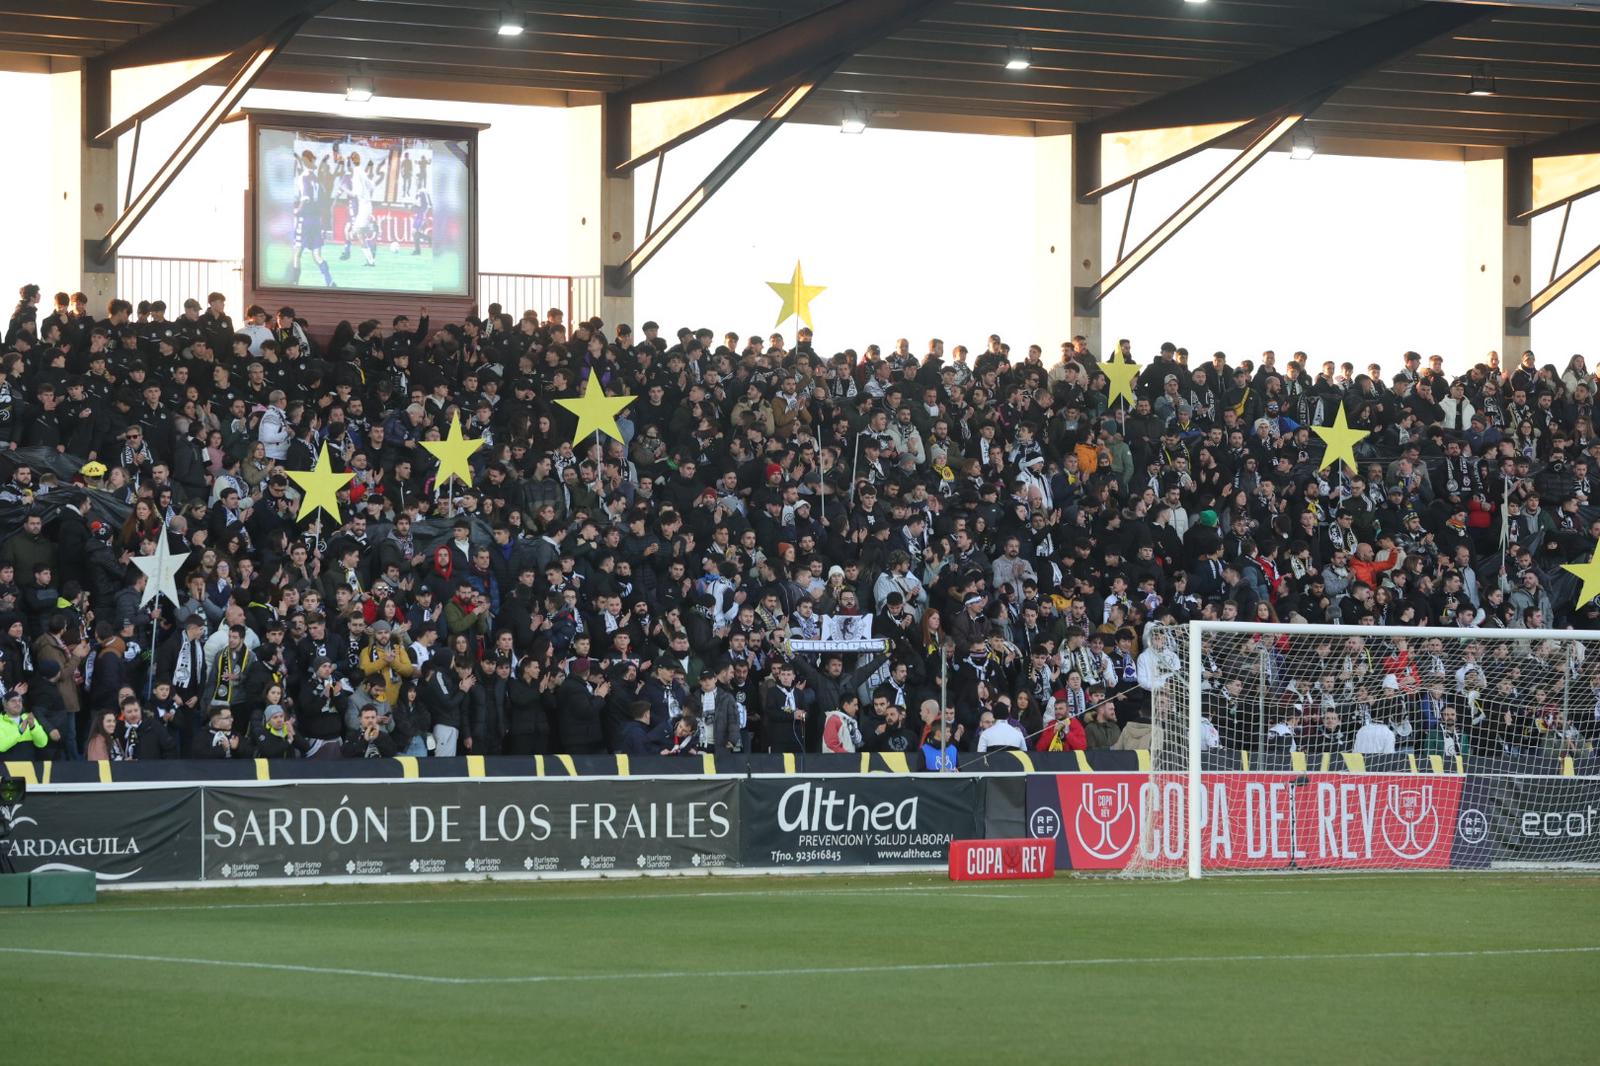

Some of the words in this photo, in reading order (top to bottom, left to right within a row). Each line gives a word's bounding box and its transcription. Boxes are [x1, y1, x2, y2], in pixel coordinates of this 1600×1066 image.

[213, 794, 388, 848] SARDÓN
[410, 805, 461, 842] DE
[479, 804, 551, 842] LOS
[570, 801, 730, 840] FRAILES
[1246, 782, 1307, 859] DEL
[1318, 782, 1378, 859] REY
[798, 834, 863, 847] PREVENCION
[866, 834, 873, 846] Y
[771, 850, 794, 863] Tfno.
[796, 850, 841, 862] 923616845
[877, 848, 942, 859] www.althea.es
[966, 847, 1003, 875] COPA
[1021, 846, 1047, 873] REY
